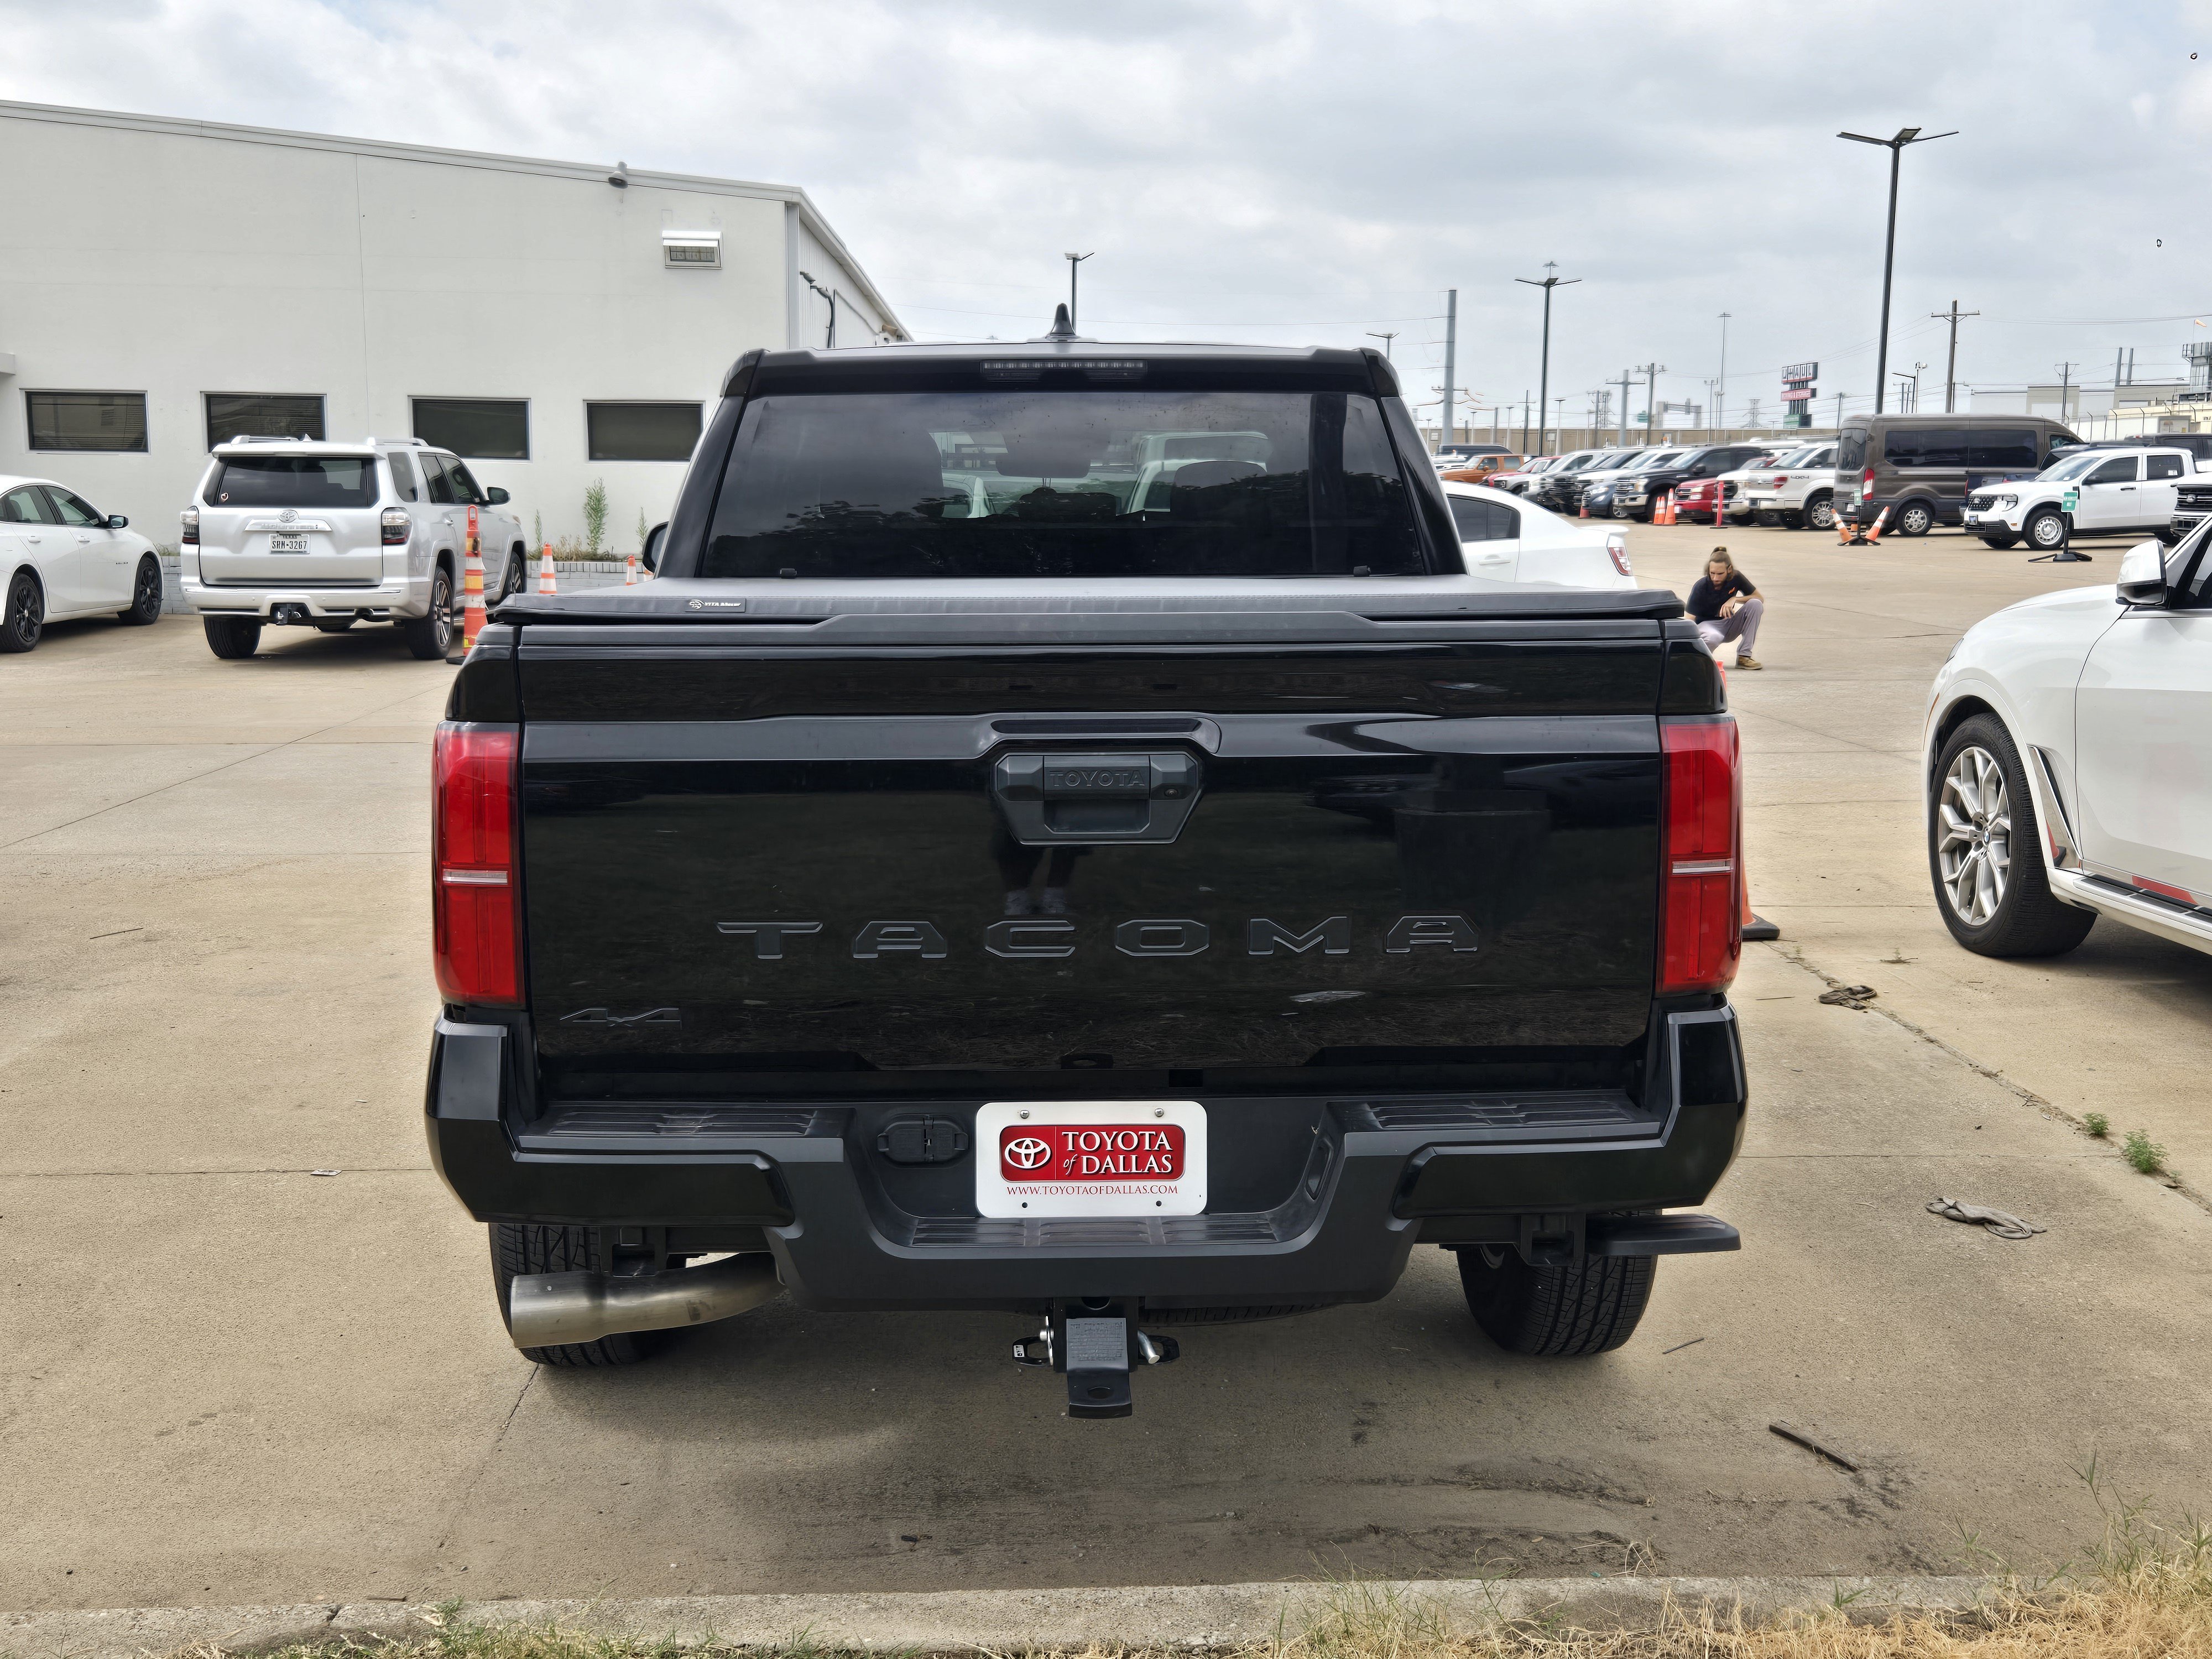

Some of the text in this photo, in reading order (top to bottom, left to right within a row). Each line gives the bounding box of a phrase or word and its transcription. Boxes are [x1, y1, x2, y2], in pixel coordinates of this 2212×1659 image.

[1049, 769, 1145, 786] TOYOTA
[717, 916, 1479, 959] TACOMA
[1062, 1130, 1173, 1151] TOYOTA
[1062, 1153, 1172, 1176] of DALLAS
[1006, 1184, 1178, 1196] WWW.TOYOTAOFDALLAS.COM
